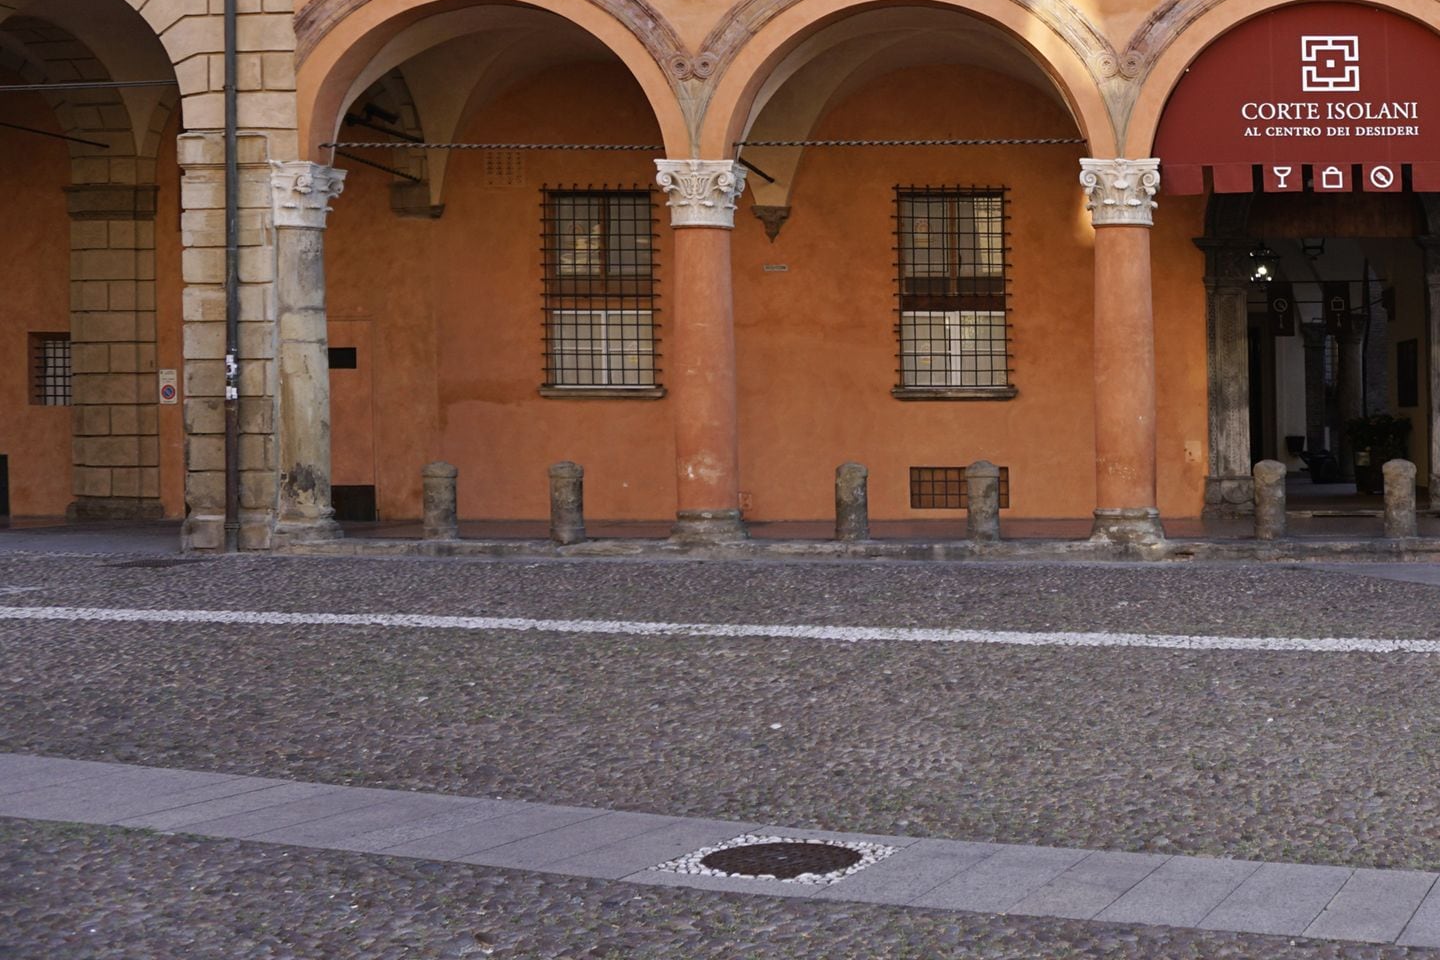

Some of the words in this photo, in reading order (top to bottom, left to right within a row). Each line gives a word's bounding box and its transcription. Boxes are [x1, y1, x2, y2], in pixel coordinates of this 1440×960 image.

[1241, 102, 1320, 120] CORTE
[1327, 102, 1419, 120] ISOLANI
[1244, 126, 1261, 136] AL
[1266, 126, 1321, 136] CENTRO
[1327, 126, 1350, 136] DEI
[1356, 126, 1419, 136] DESIDERI
